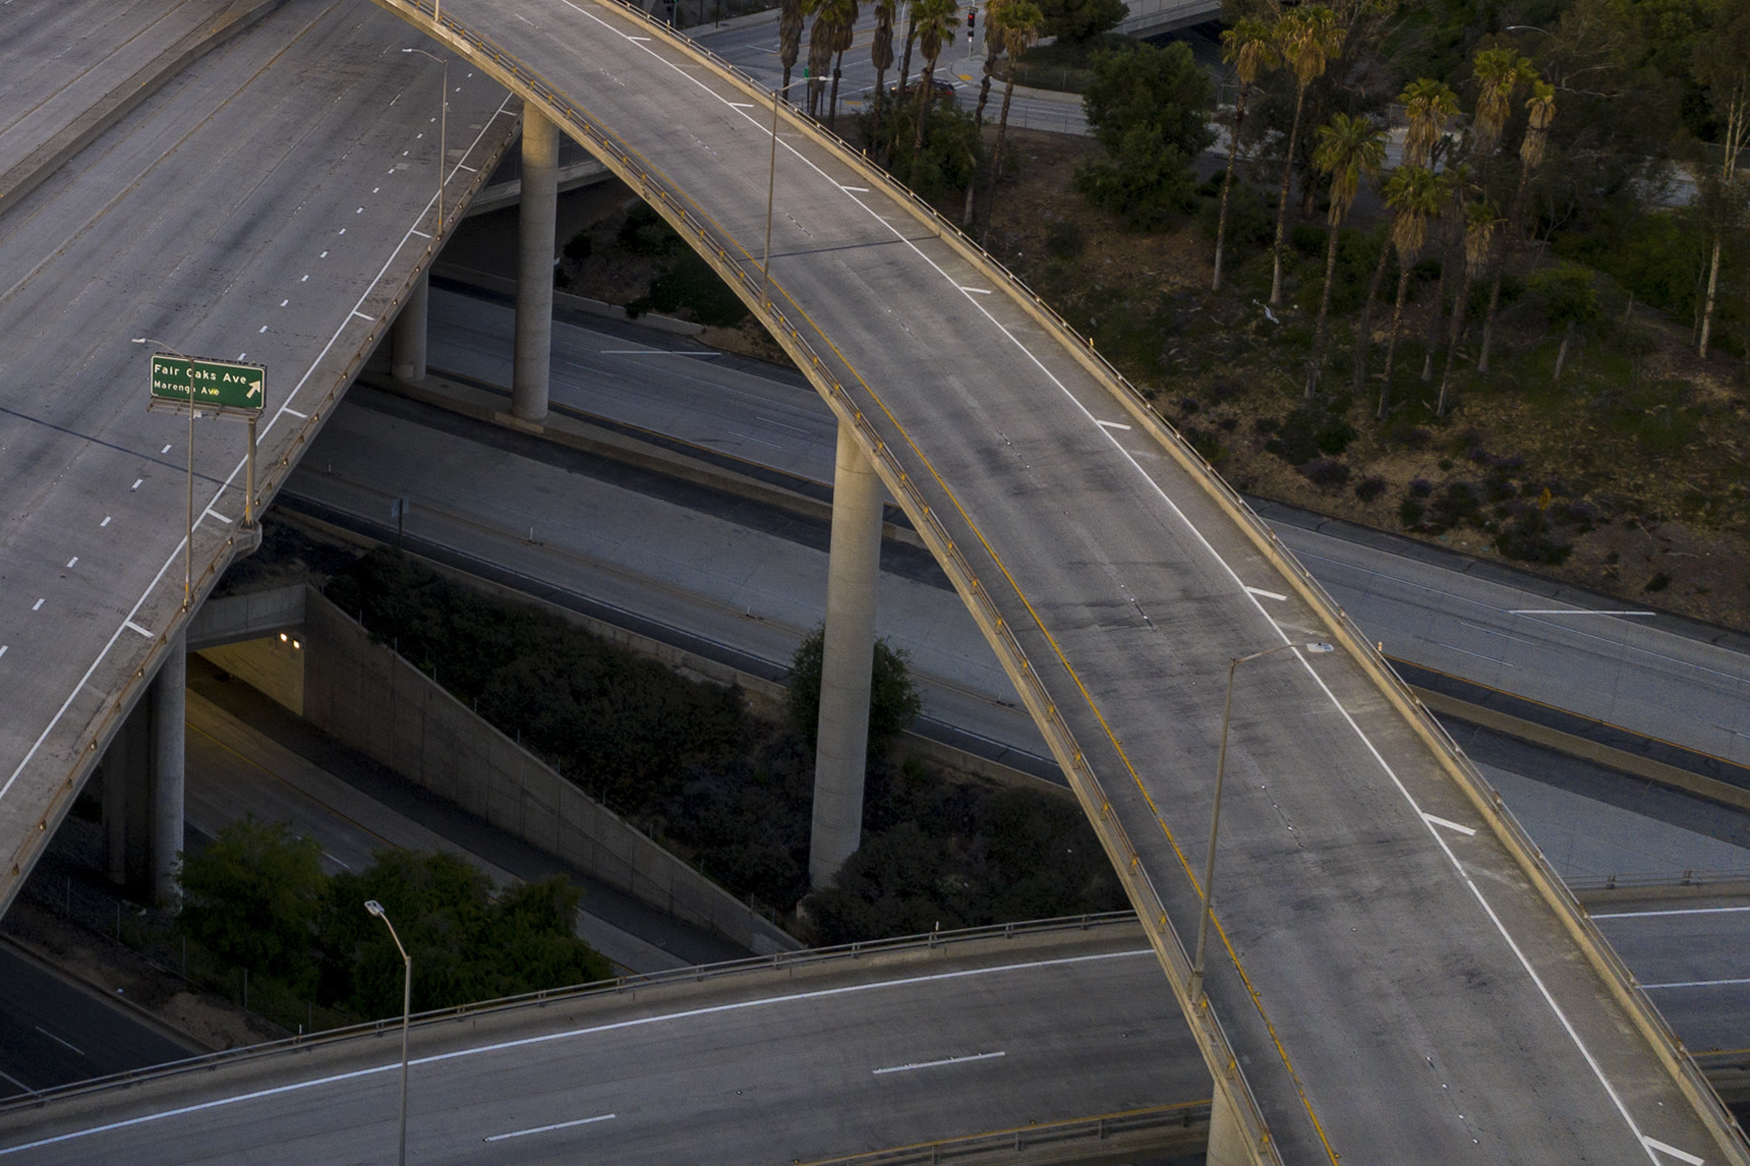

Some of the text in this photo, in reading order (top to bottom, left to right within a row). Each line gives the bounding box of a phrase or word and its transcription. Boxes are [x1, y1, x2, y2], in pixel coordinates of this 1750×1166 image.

[154, 364, 180, 376] Fair
[223, 372, 247, 385] Ave
[201, 386, 220, 396] Ave
